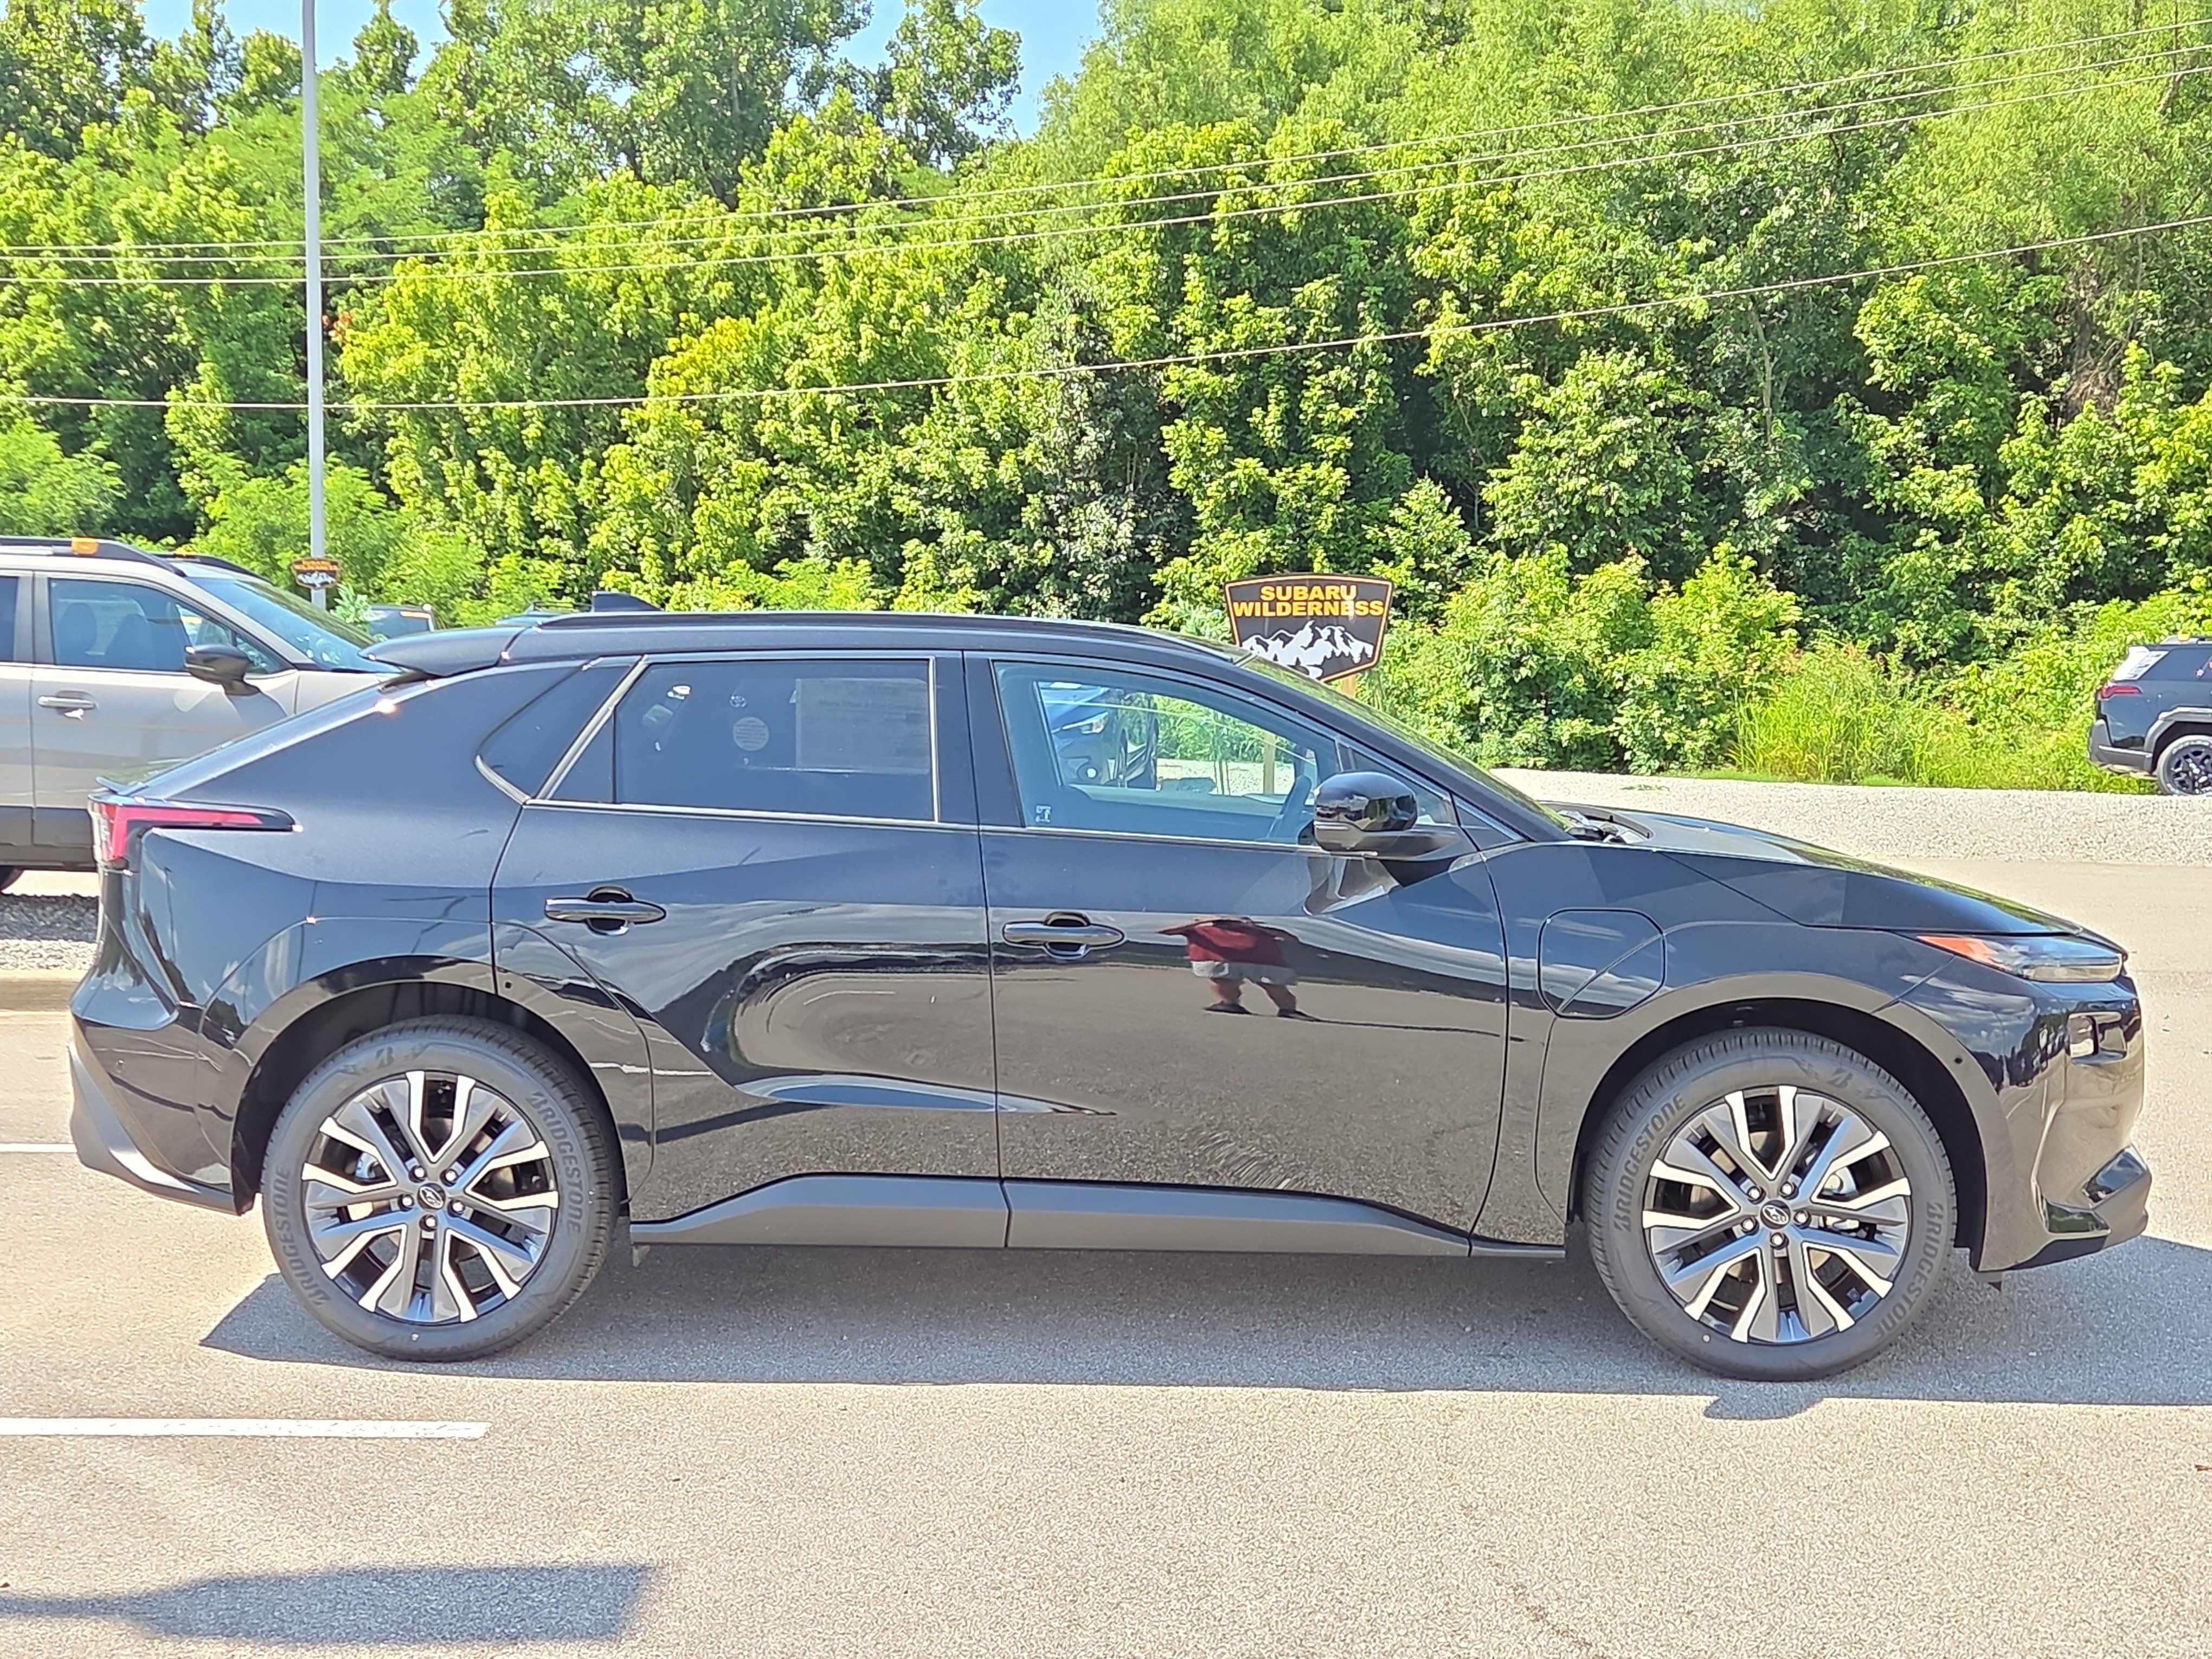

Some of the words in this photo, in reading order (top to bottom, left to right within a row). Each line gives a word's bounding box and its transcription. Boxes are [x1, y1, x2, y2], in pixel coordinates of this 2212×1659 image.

[1233, 600, 1384, 617] WILDERNESS
[1260, 584, 1356, 601] SUBARU
[525, 1091, 583, 1233] BRIDGESTONE
[1613, 1092, 1686, 1232] BRIDGESTONE
[272, 1165, 331, 1306] BRIDGESTONE
[1874, 1201, 1944, 1342] BRIDGESTONE
